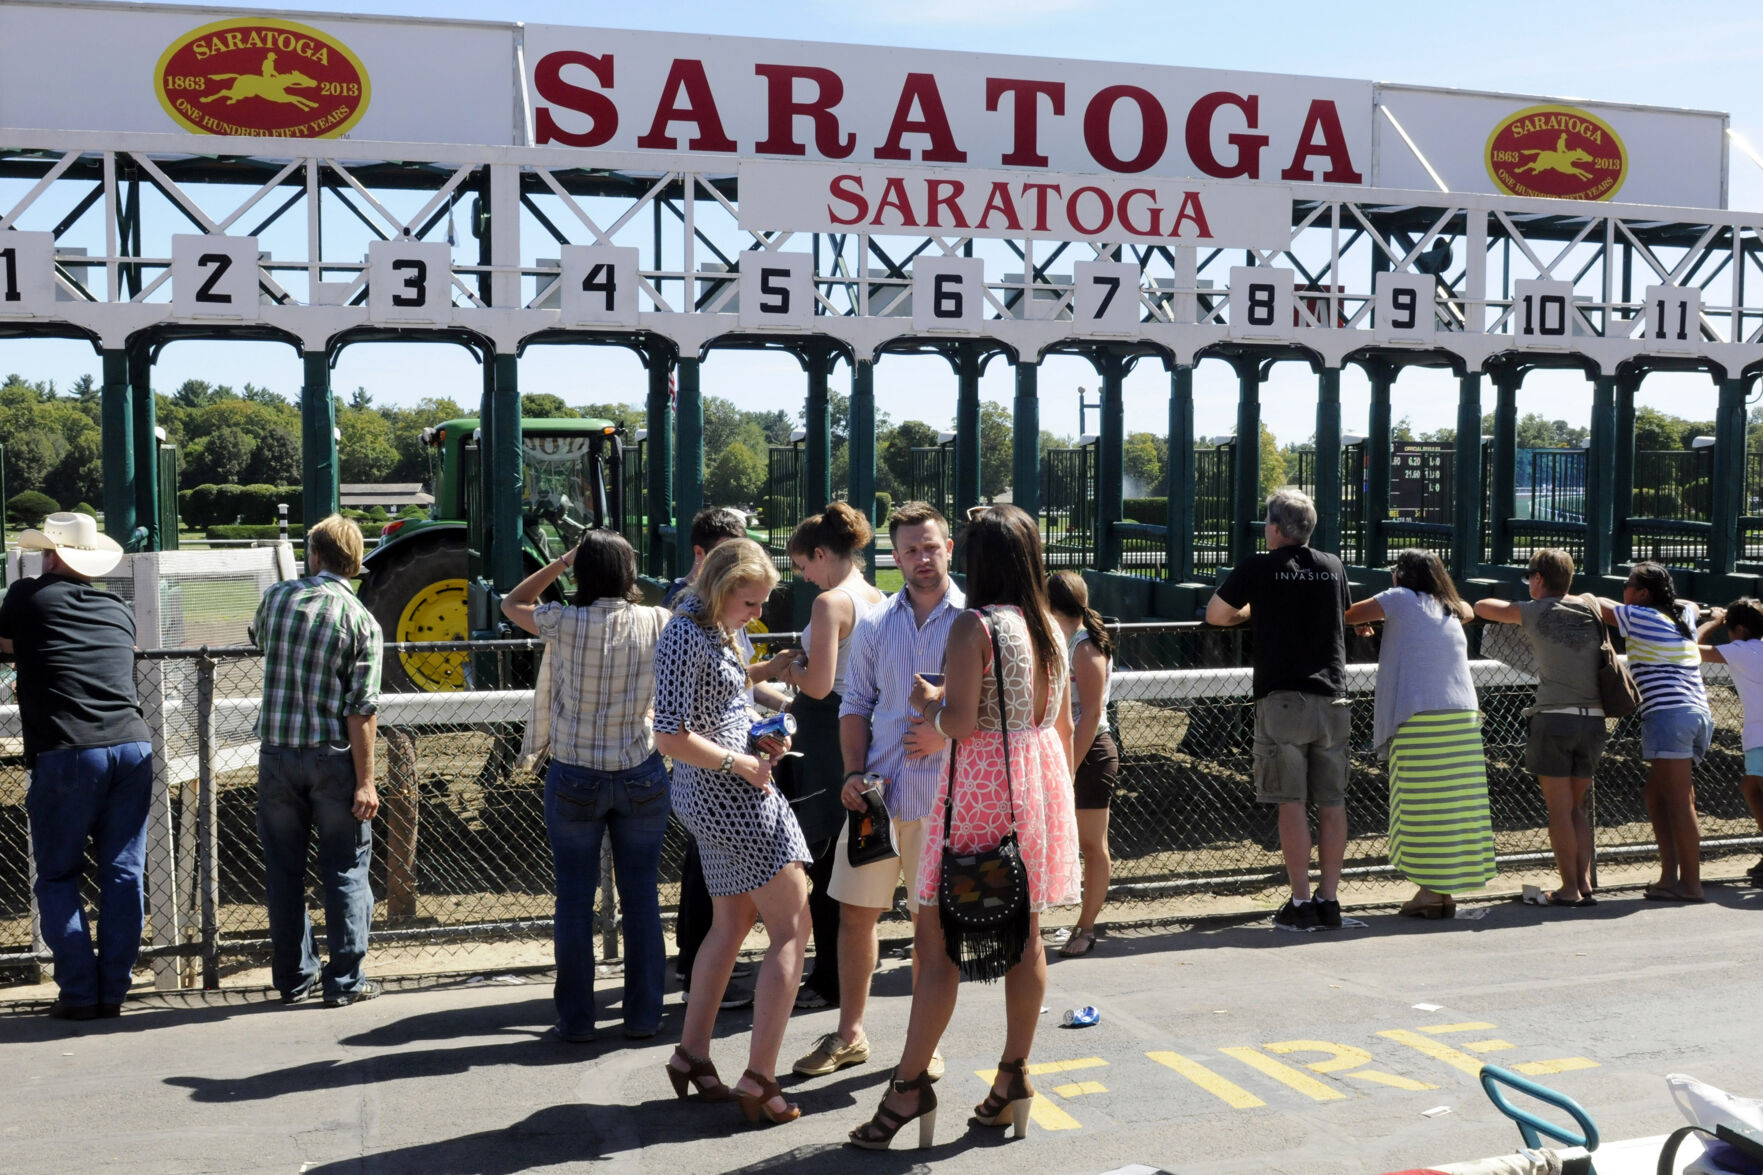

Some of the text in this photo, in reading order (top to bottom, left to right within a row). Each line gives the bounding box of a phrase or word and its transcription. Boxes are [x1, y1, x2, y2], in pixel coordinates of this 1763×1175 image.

[193, 30, 328, 66] SARATOGA
[166, 76, 205, 90] 1863
[320, 81, 359, 96] 2013
[176, 98, 350, 138] ONE HUNDRED FIFTY YEARS
[534, 50, 1363, 184] SARATOGA
[1511, 115, 1602, 145] SARATOGA
[1493, 150, 1519, 163] 1863
[1595, 157, 1620, 170] 2013
[1498, 168, 1516, 187] ONE
[1586, 176, 1614, 198] YEARS
[829, 174, 1214, 239] SARATOGA
[0, 248, 20, 301] 1
[195, 254, 233, 304] 2
[392, 259, 426, 307] 3
[582, 264, 616, 312] 4
[760, 268, 791, 314] 5
[934, 274, 963, 318] 6
[1093, 276, 1120, 320] 7
[1248, 284, 1275, 326] 8
[1392, 288, 1416, 329] 9
[1523, 295, 1565, 336] 10
[1655, 300, 1687, 340] 11
[1275, 571, 1338, 581] INVASION
[973, 1022, 1600, 1131] FIRE
